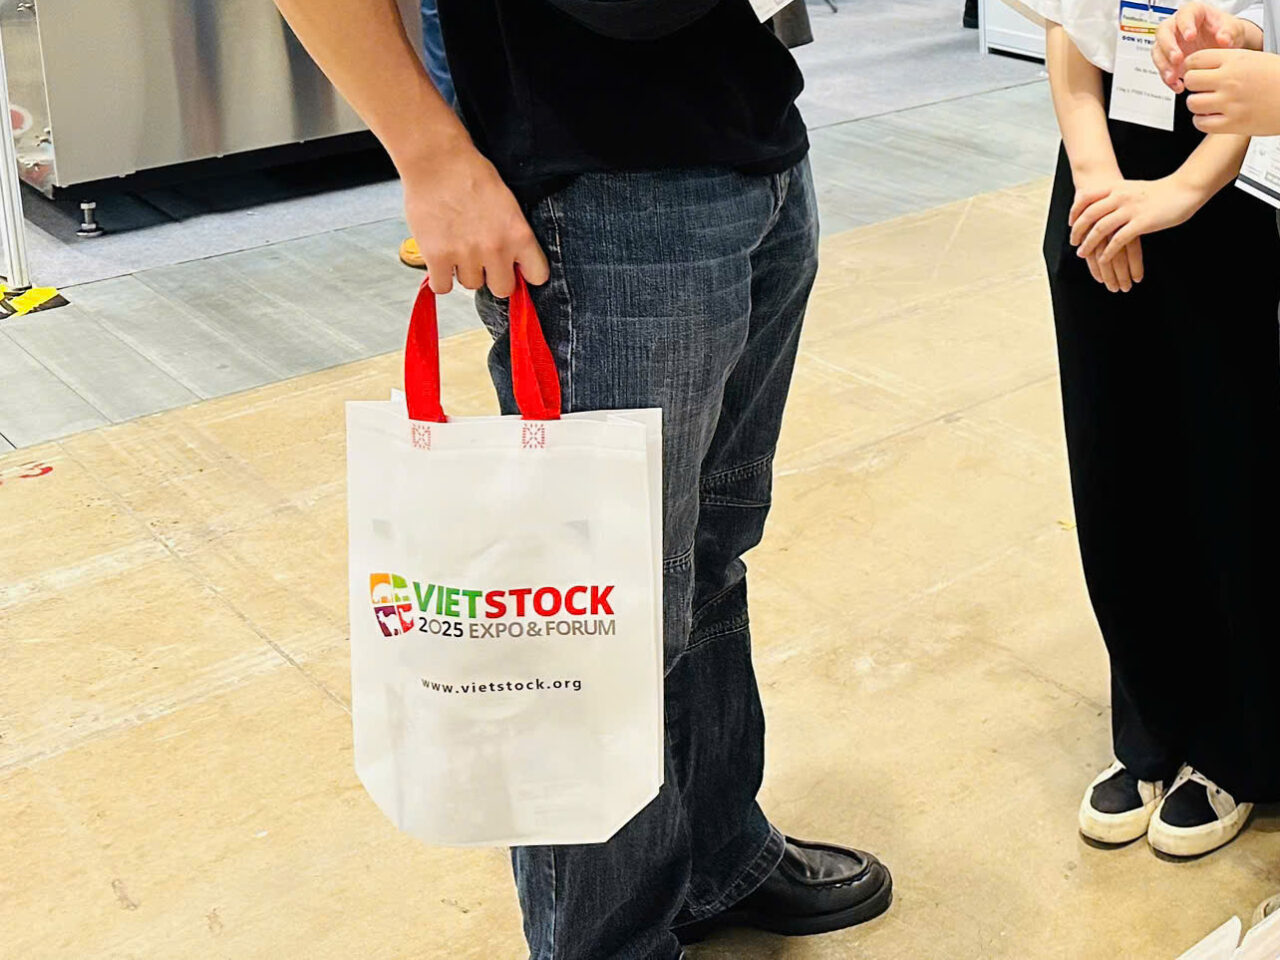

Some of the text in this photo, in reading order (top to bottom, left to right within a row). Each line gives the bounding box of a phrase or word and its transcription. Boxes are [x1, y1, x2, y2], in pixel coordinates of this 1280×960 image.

[412, 581, 615, 619] VIETSTOCK
[418, 616, 464, 638] 2025
[421, 677, 582, 695] www.vietstock.org
